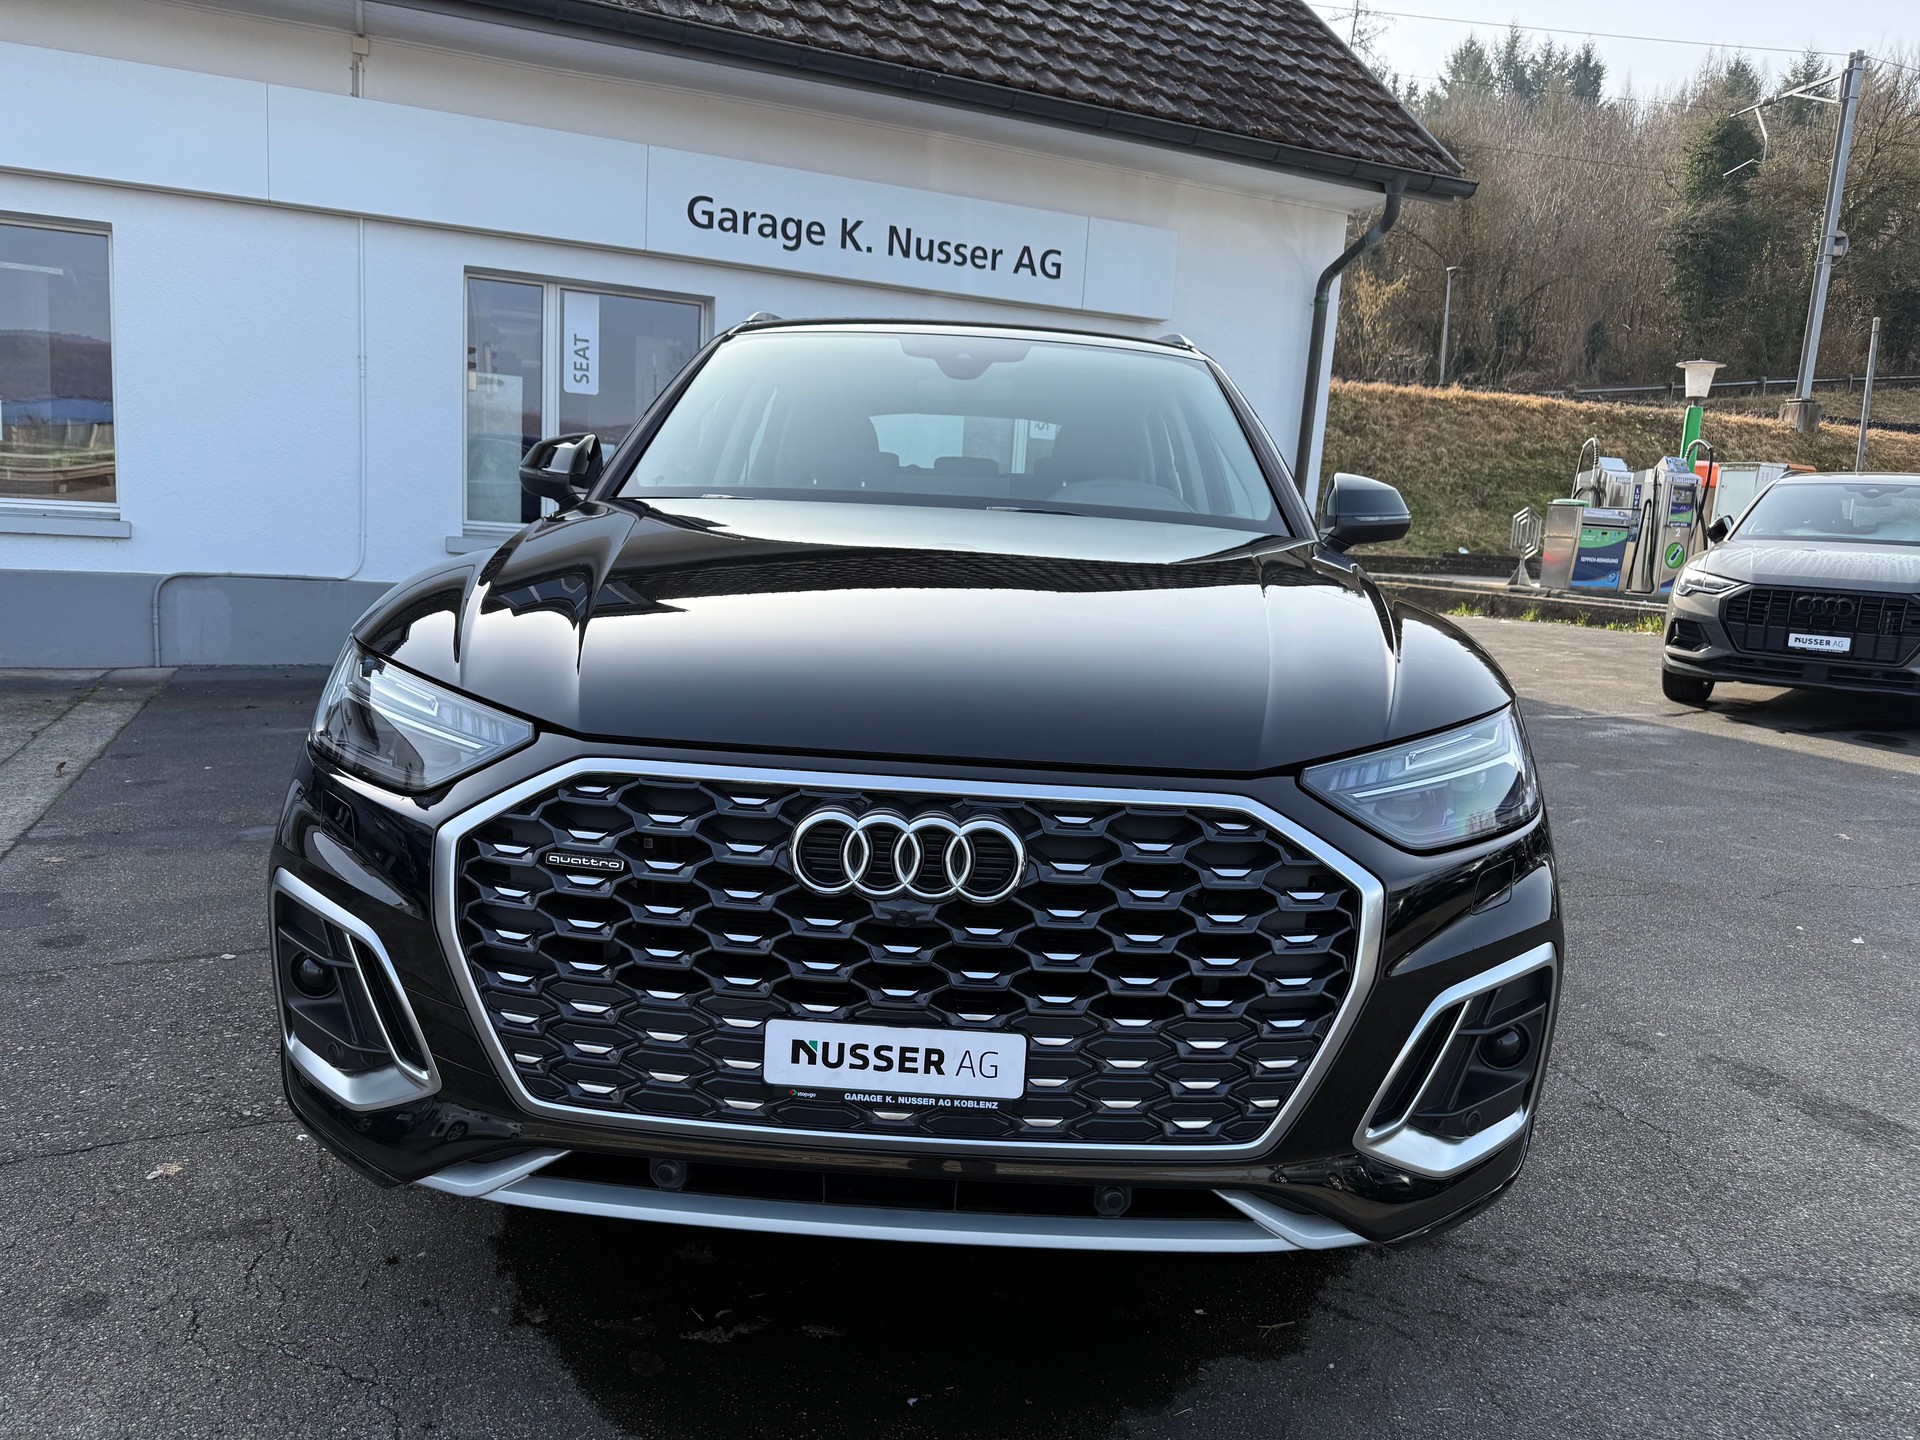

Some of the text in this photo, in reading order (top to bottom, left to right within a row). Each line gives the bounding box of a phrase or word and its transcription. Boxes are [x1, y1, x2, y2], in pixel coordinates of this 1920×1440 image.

[687, 195, 1063, 280] Garage K. Nusser AG
[573, 333, 590, 384] SEAT
[1675, 528, 1681, 538] 2
[1794, 636, 1844, 648] NUSSER AG
[548, 855, 620, 868] quattro
[790, 1038, 999, 1079] NUSSER AG
[844, 1092, 999, 1109] GARAGE K. NUSSER AG KOBLENZ
